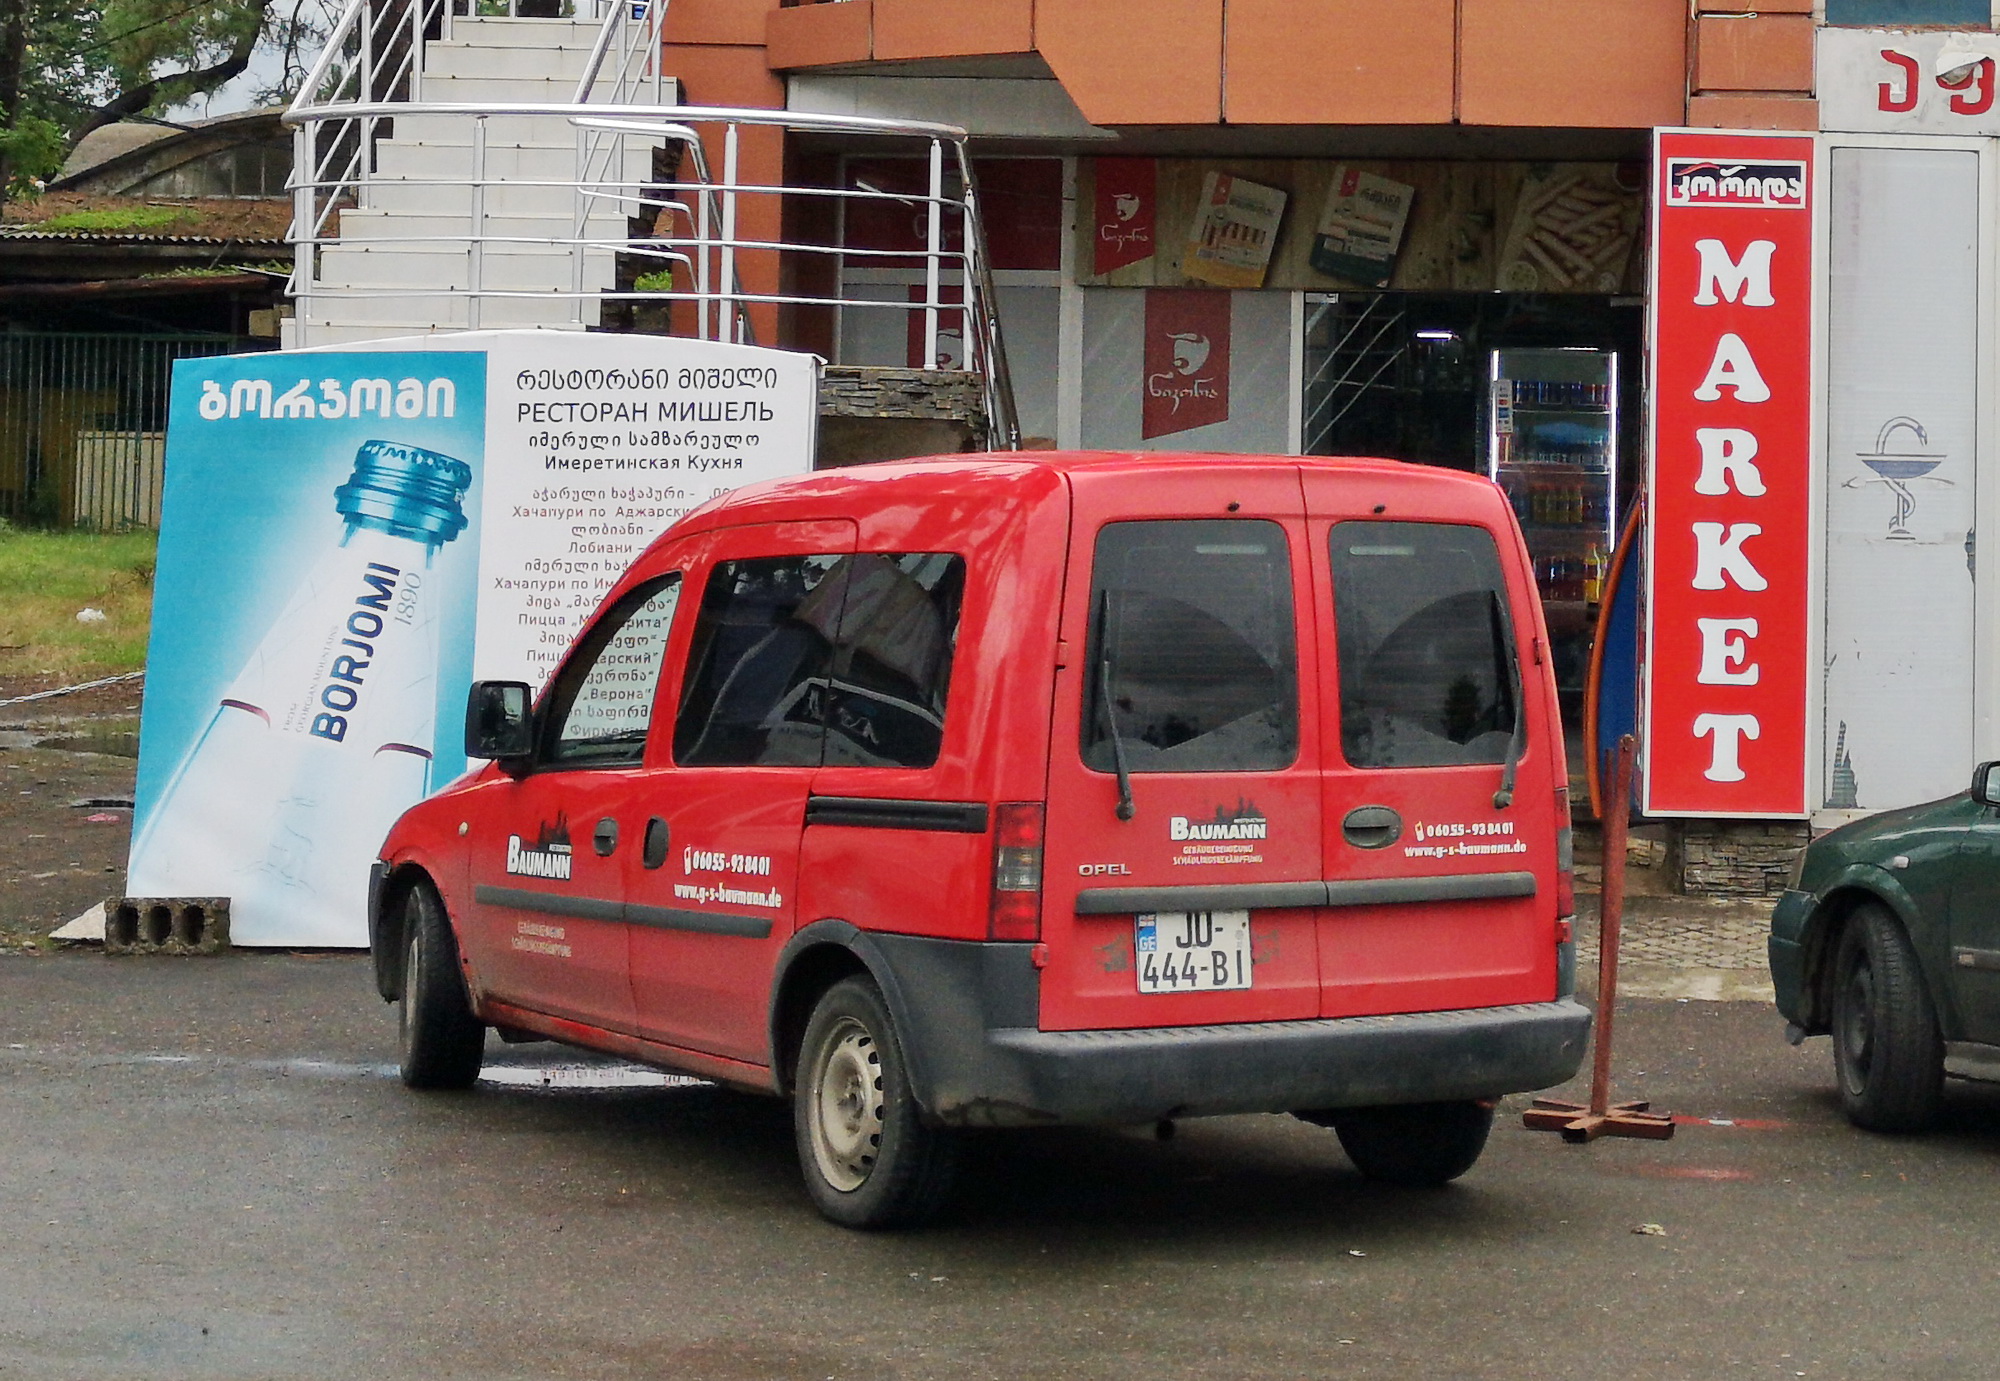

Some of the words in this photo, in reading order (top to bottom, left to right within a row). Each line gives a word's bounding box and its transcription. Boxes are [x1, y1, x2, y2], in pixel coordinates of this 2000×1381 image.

[516, 369, 669, 391] რესტორანი
[678, 367, 778, 390] მიშელი
[199, 376, 456, 421] ბორჯომი
[517, 402, 648, 423] РЕСТОРАН
[658, 401, 775, 423] МИШЕЛЬ
[529, 431, 621, 450] იმერული
[628, 431, 760, 450] სამზარეულო
[545, 455, 680, 473] Имеретинская
[687, 455, 743, 473] Кухня
[532, 486, 606, 502] აჭარული
[512, 506, 583, 520] Хачапури
[1692, 239, 1777, 783] MARKET
[571, 523, 644, 538] ლობიანი
[568, 542, 632, 554] Лобиани
[525, 559, 599, 574] იმერული
[494, 577, 565, 592] Хачапури
[571, 580, 588, 589] по
[394, 571, 422, 626] 1890
[526, 594, 561, 610] პიცა
[518, 613, 565, 627] Пицца
[309, 562, 401, 743] BORJOMI
[1170, 816, 1267, 841] BAUMANN
[507, 835, 572, 880] BAUMANN
[1078, 863, 1132, 876] OPEL
[1140, 936, 1157, 951] GE
